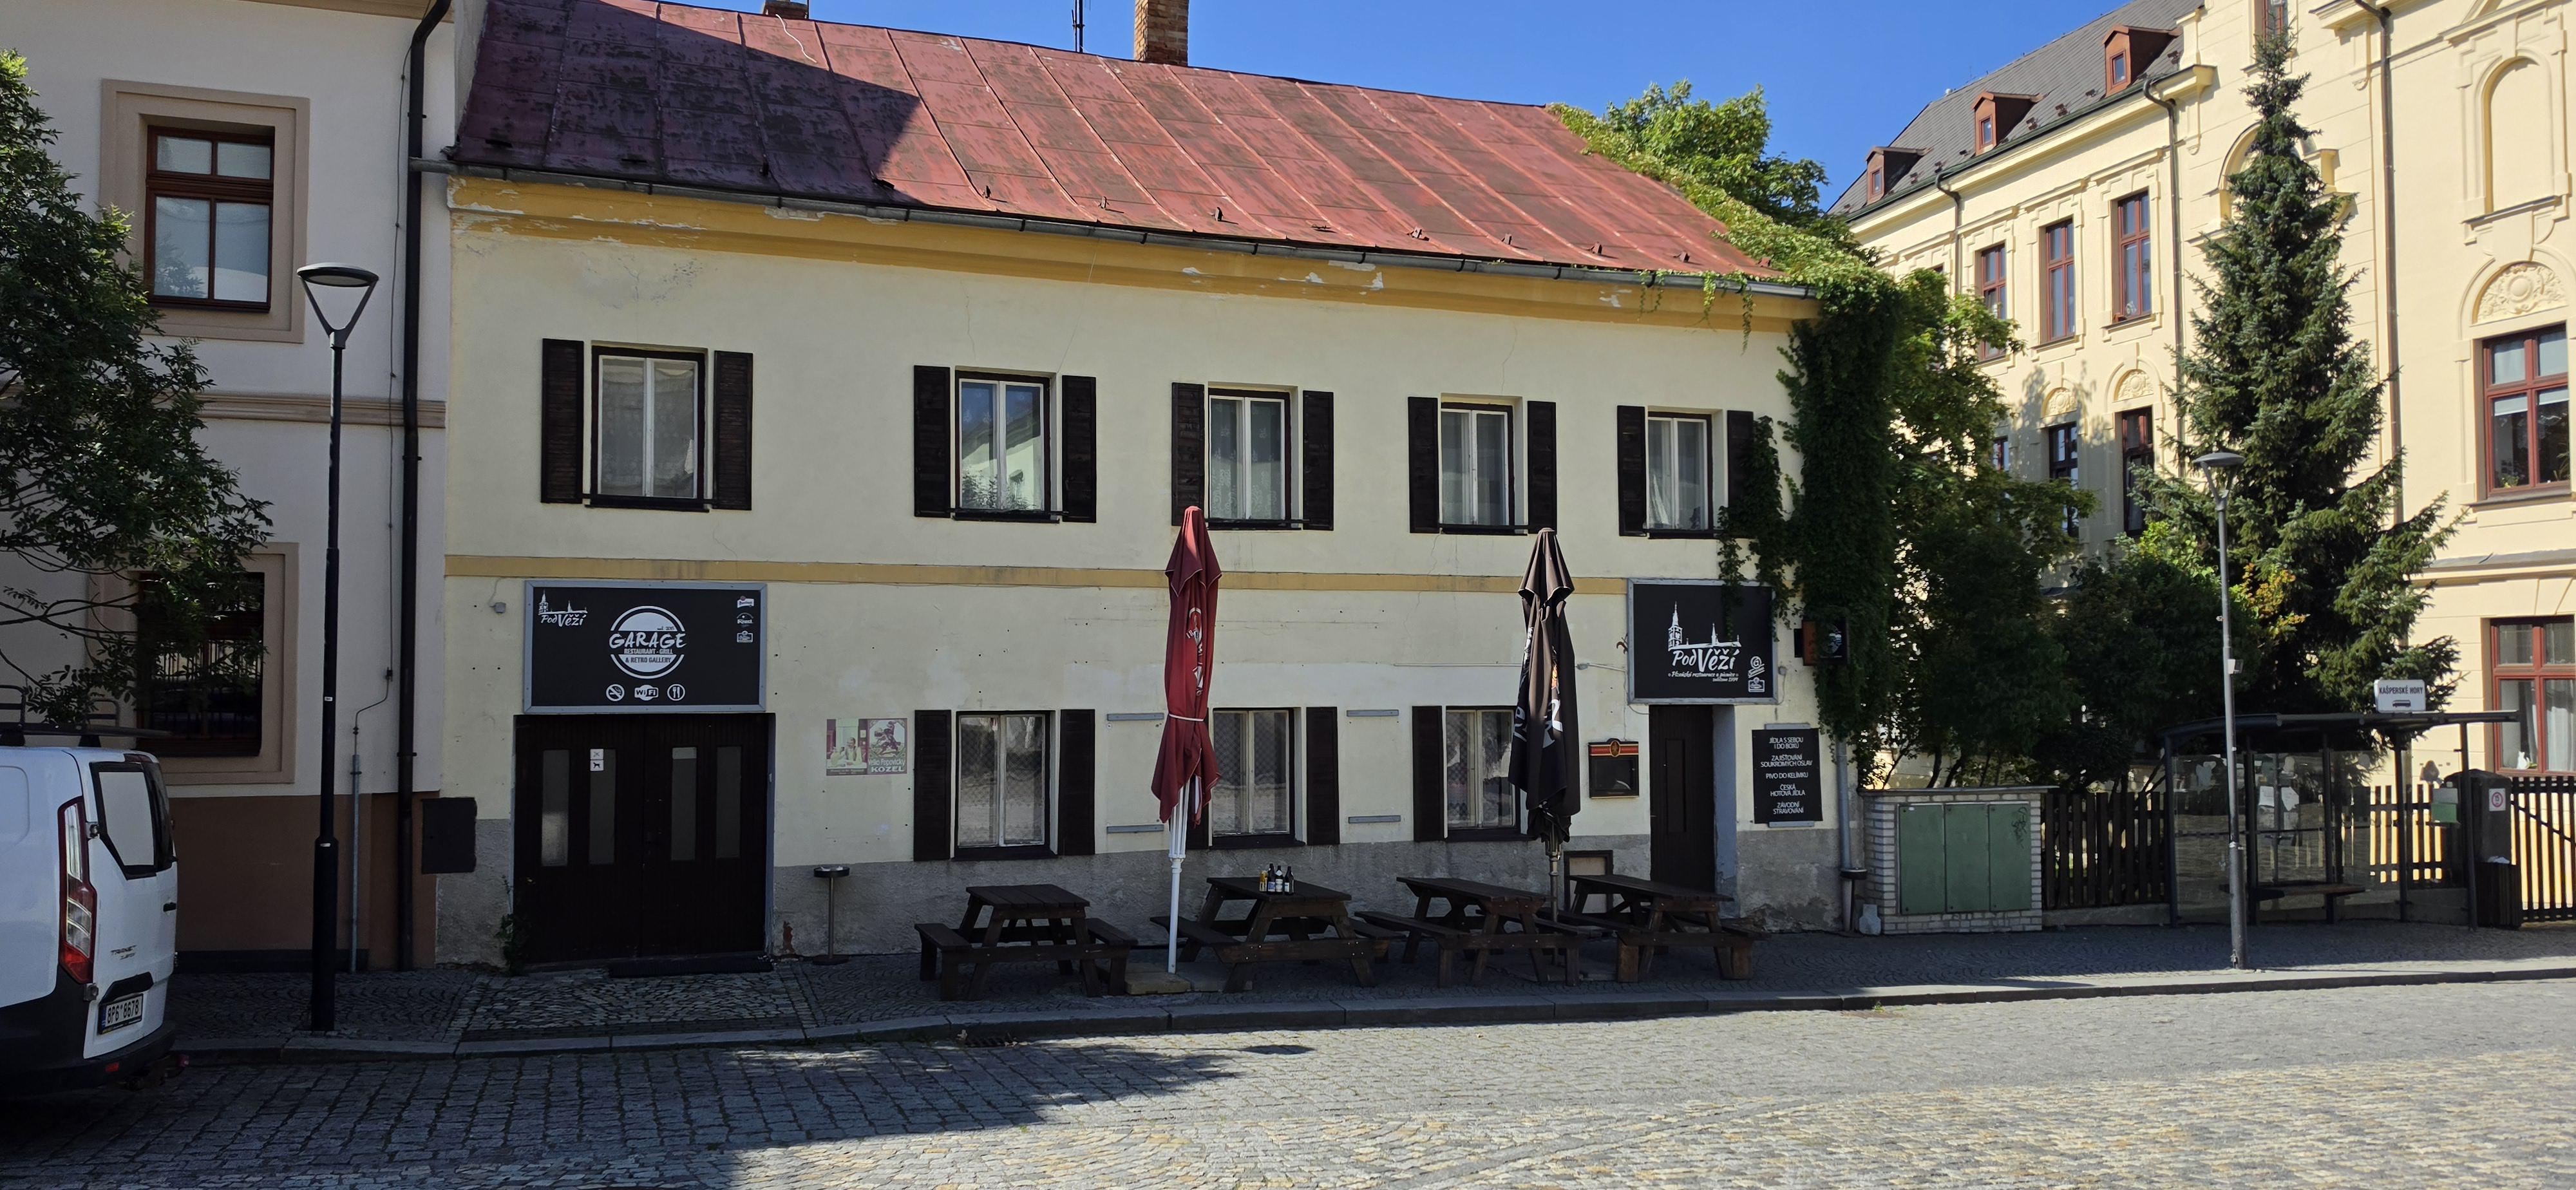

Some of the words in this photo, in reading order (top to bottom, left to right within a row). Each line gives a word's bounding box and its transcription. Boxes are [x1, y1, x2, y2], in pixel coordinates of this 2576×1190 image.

[541, 614, 558, 623] Pod
[558, 614, 587, 627] Věží
[609, 631, 687, 649] GARAGE
[1672, 649, 1696, 666] Pod
[1698, 647, 1740, 673] Věží
[2379, 685, 2408, 694] KAŠPERSKÉ
[107, 1005, 119, 1024] 8P6
[122, 999, 140, 1019] 8678
